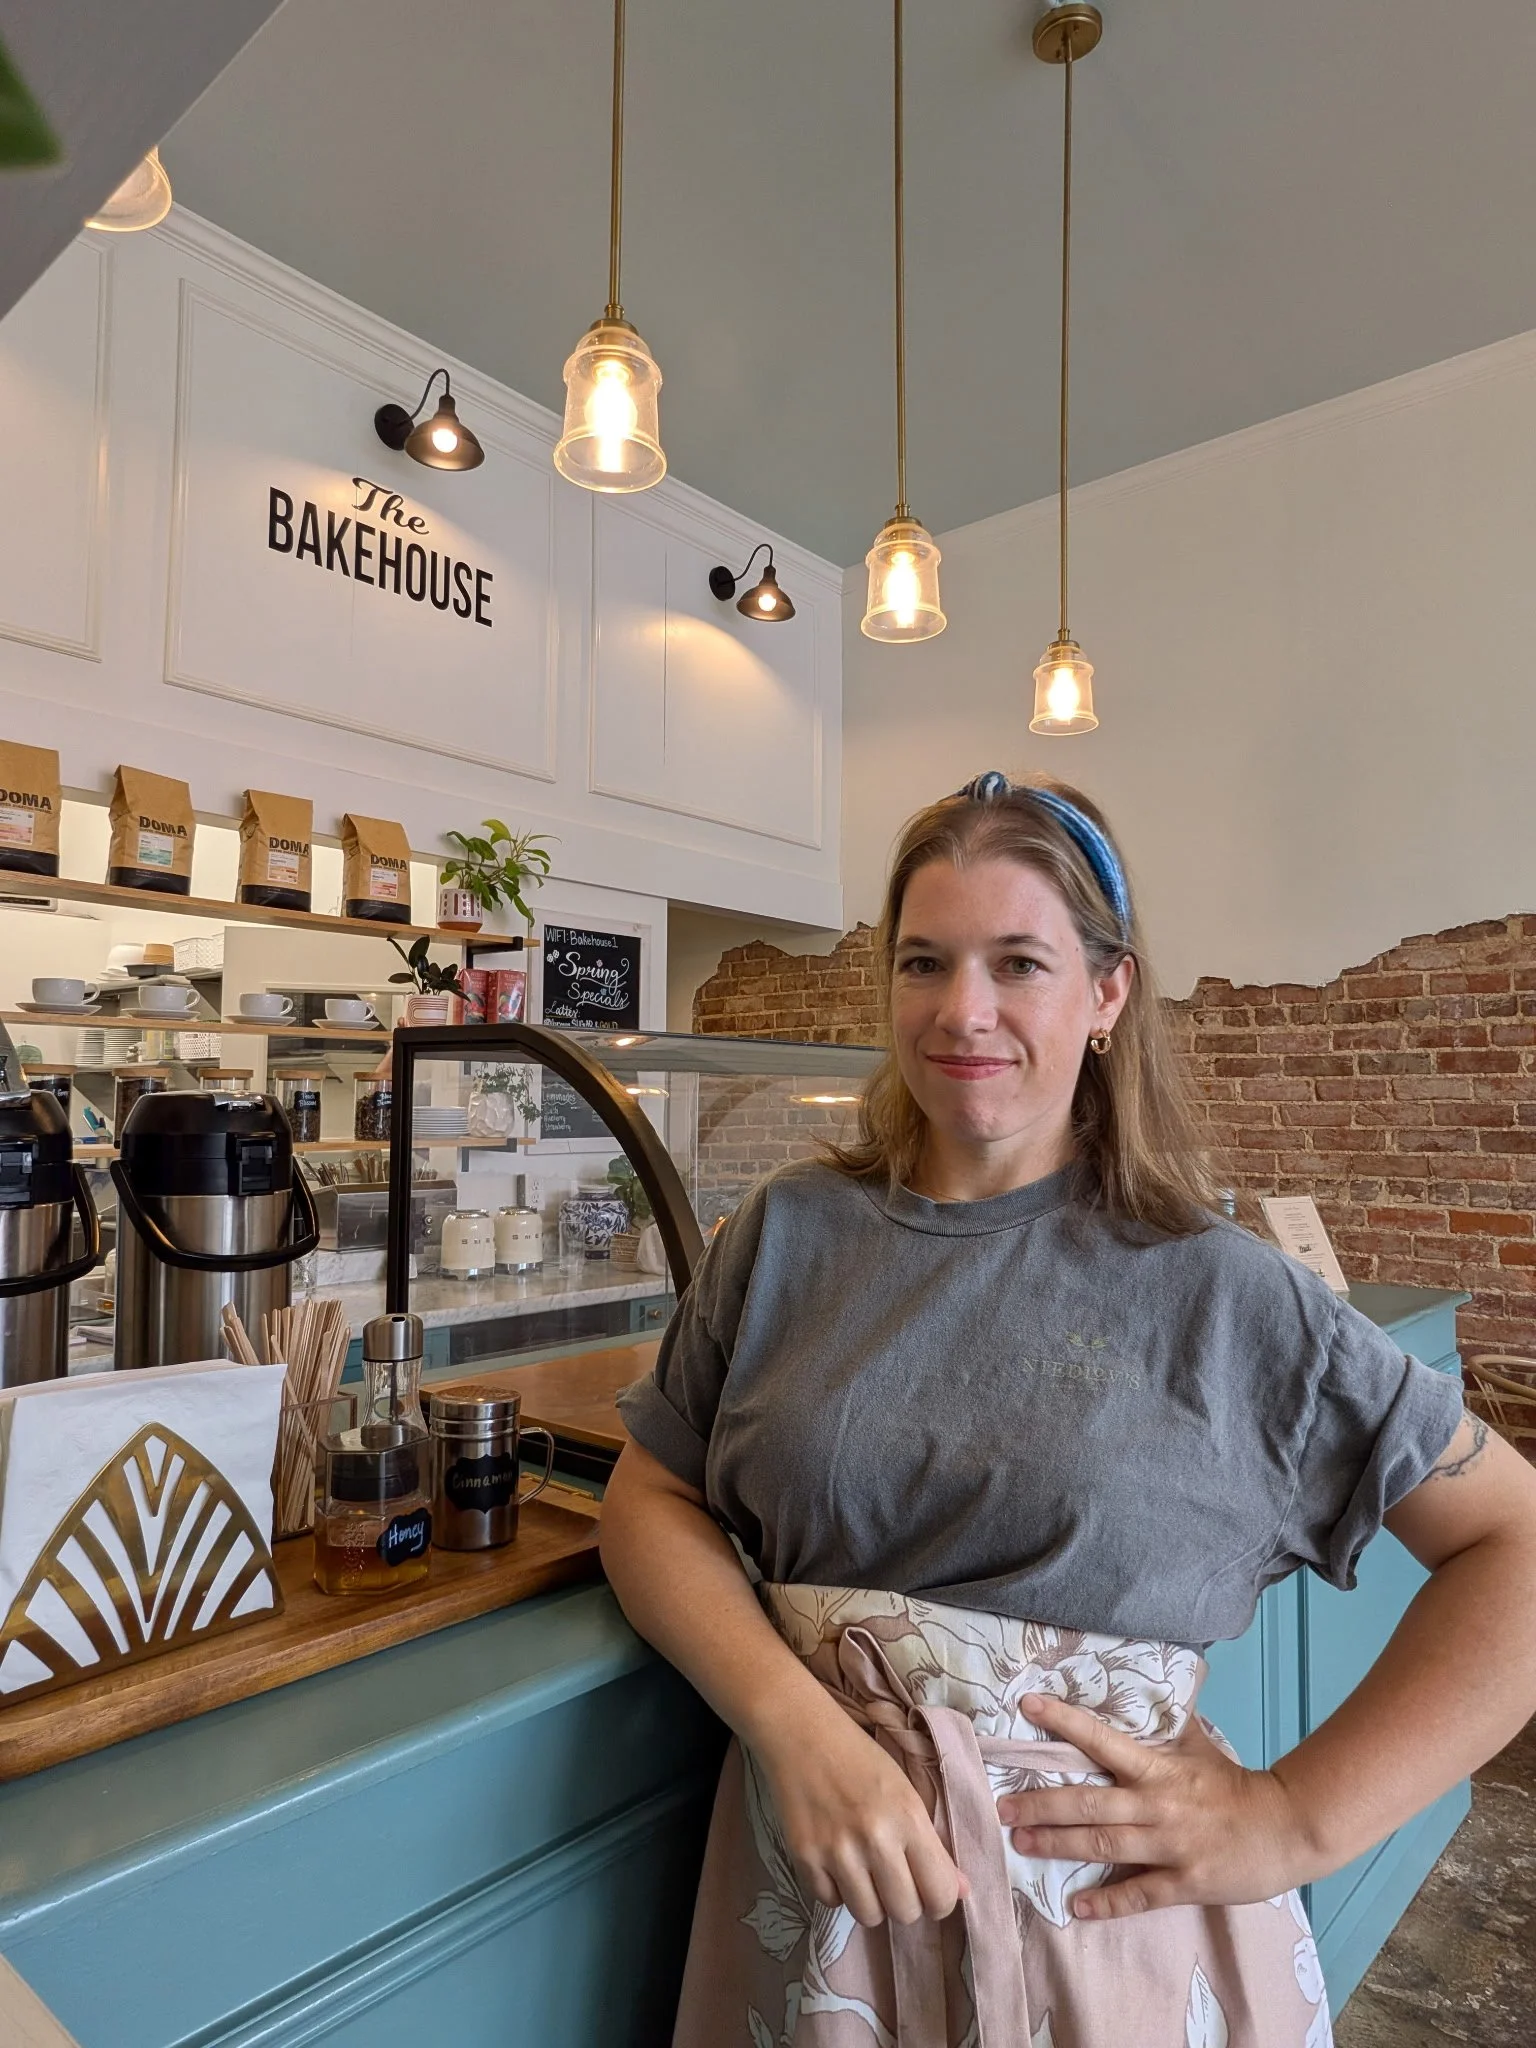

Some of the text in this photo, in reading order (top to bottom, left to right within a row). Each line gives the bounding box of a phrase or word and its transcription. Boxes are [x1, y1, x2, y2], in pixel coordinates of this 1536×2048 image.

[351, 477, 430, 535] The
[268, 486, 494, 628] BAKEHOUSE
[138, 815, 188, 837] DOMA
[269, 836, 310, 856] DOMA
[370, 853, 408, 870] DOMA
[559, 951, 630, 995] Spring
[567, 982, 630, 1008] Specials
[388, 1520, 425, 1552] Honey
